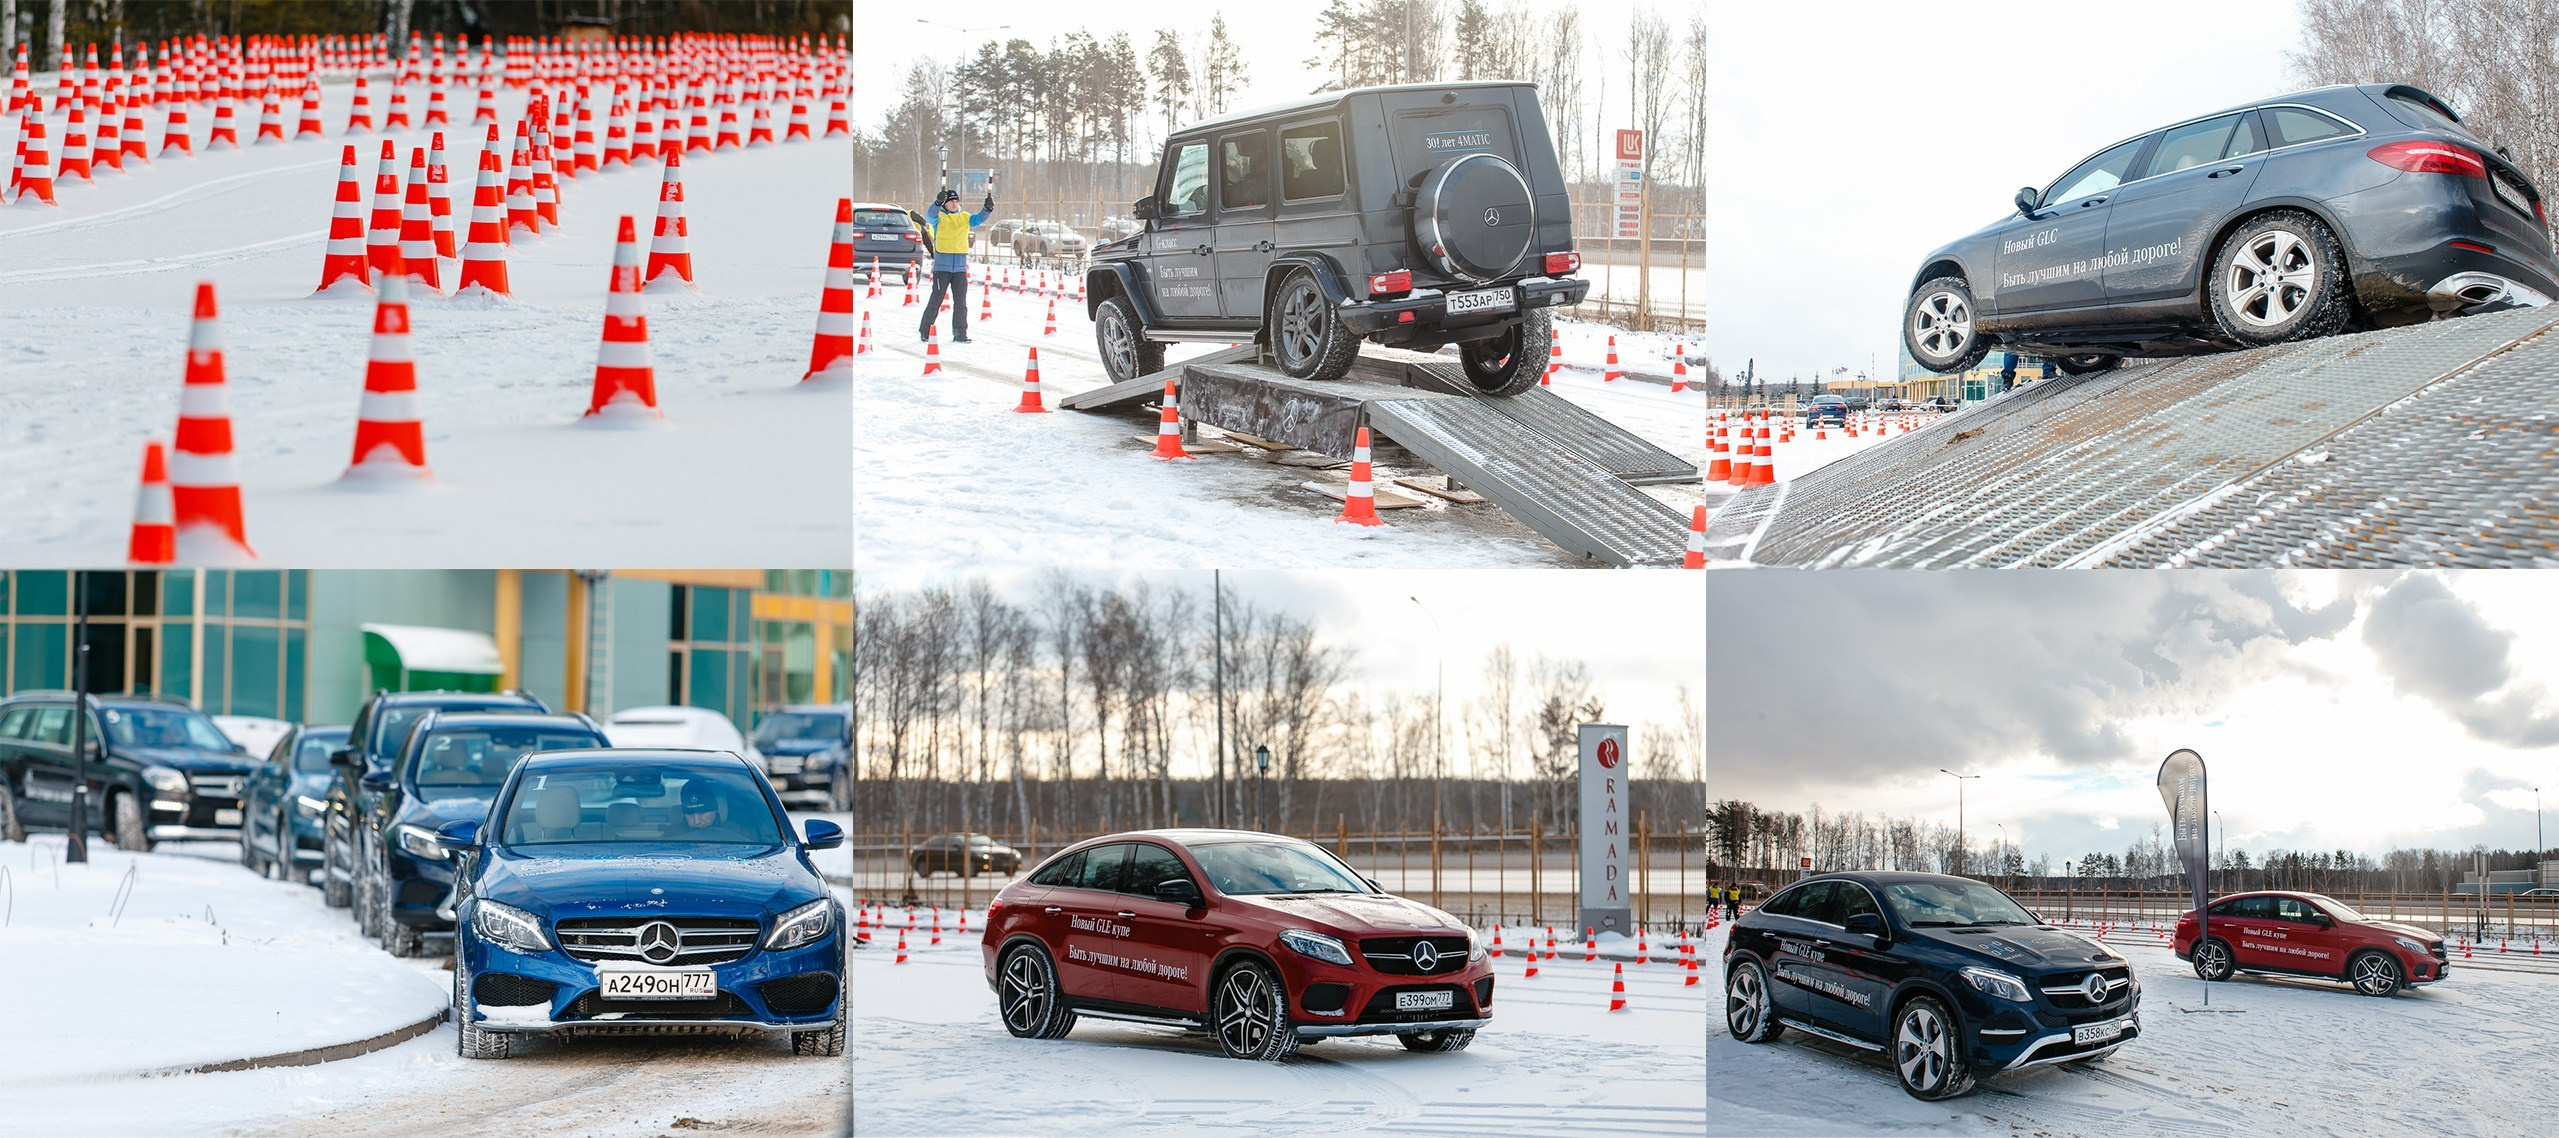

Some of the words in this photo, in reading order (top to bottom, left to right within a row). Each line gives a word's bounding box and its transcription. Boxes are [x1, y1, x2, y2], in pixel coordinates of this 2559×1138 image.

[1426, 137, 1440, 149] 30!
[1441, 139, 1455, 148] лет
[1458, 133, 1491, 147] 4MATIC
[1156, 237, 1177, 249] G-класс
[2003, 235, 2035, 255] Новый
[2037, 228, 2059, 247] GLC
[2002, 271, 2026, 288] Быть
[2028, 264, 2070, 285] лучшим
[2073, 259, 2086, 274] на
[2089, 247, 2129, 271] любой
[2131, 236, 2182, 265] дороге!
[1160, 265, 1174, 278] Быть
[1175, 266, 1198, 280] лучшим
[1162, 287, 1169, 297] на
[1170, 284, 1189, 297] любой
[1190, 284, 1211, 299] дороге!
[1494, 289, 1511, 301] 750
[435, 736, 452, 751] 2
[532, 775, 548, 790] 1
[2188, 762, 2199, 792] дороге
[2178, 777, 2188, 816] лучшим
[2188, 795, 2198, 826] любой
[1604, 777, 1618, 901] RAMADA
[2177, 817, 2188, 841] Быть
[2191, 828, 2198, 840] на
[1071, 914, 1095, 931] Новый
[1096, 918, 1112, 934] GLE
[1111, 925, 1130, 938] купе
[2243, 927, 2261, 936] Новый
[2261, 929, 2273, 937] GLE
[2273, 932, 2287, 940] купе
[1780, 939, 1799, 955] Новый
[1798, 943, 1811, 959] GLE
[1810, 950, 1826, 963] купе
[2242, 940, 2255, 949] Быть
[2255, 943, 2279, 952] лучшим
[2287, 947, 2307, 957] любой
[2307, 950, 2330, 960] дороге!
[1069, 944, 1087, 961] Быть
[1087, 951, 1118, 966] лучшим
[1120, 955, 1130, 969] на
[1131, 957, 1157, 974] любой
[1158, 964, 1188, 980] дороге!
[683, 973, 711, 988] 777
[1777, 964, 1791, 979] Быть
[1790, 971, 1815, 985] лучшим
[1815, 978, 1823, 990] на
[1823, 982, 1845, 998] любой
[1844, 987, 1871, 1007] дороге!
[1437, 992, 1451, 1002] 777
